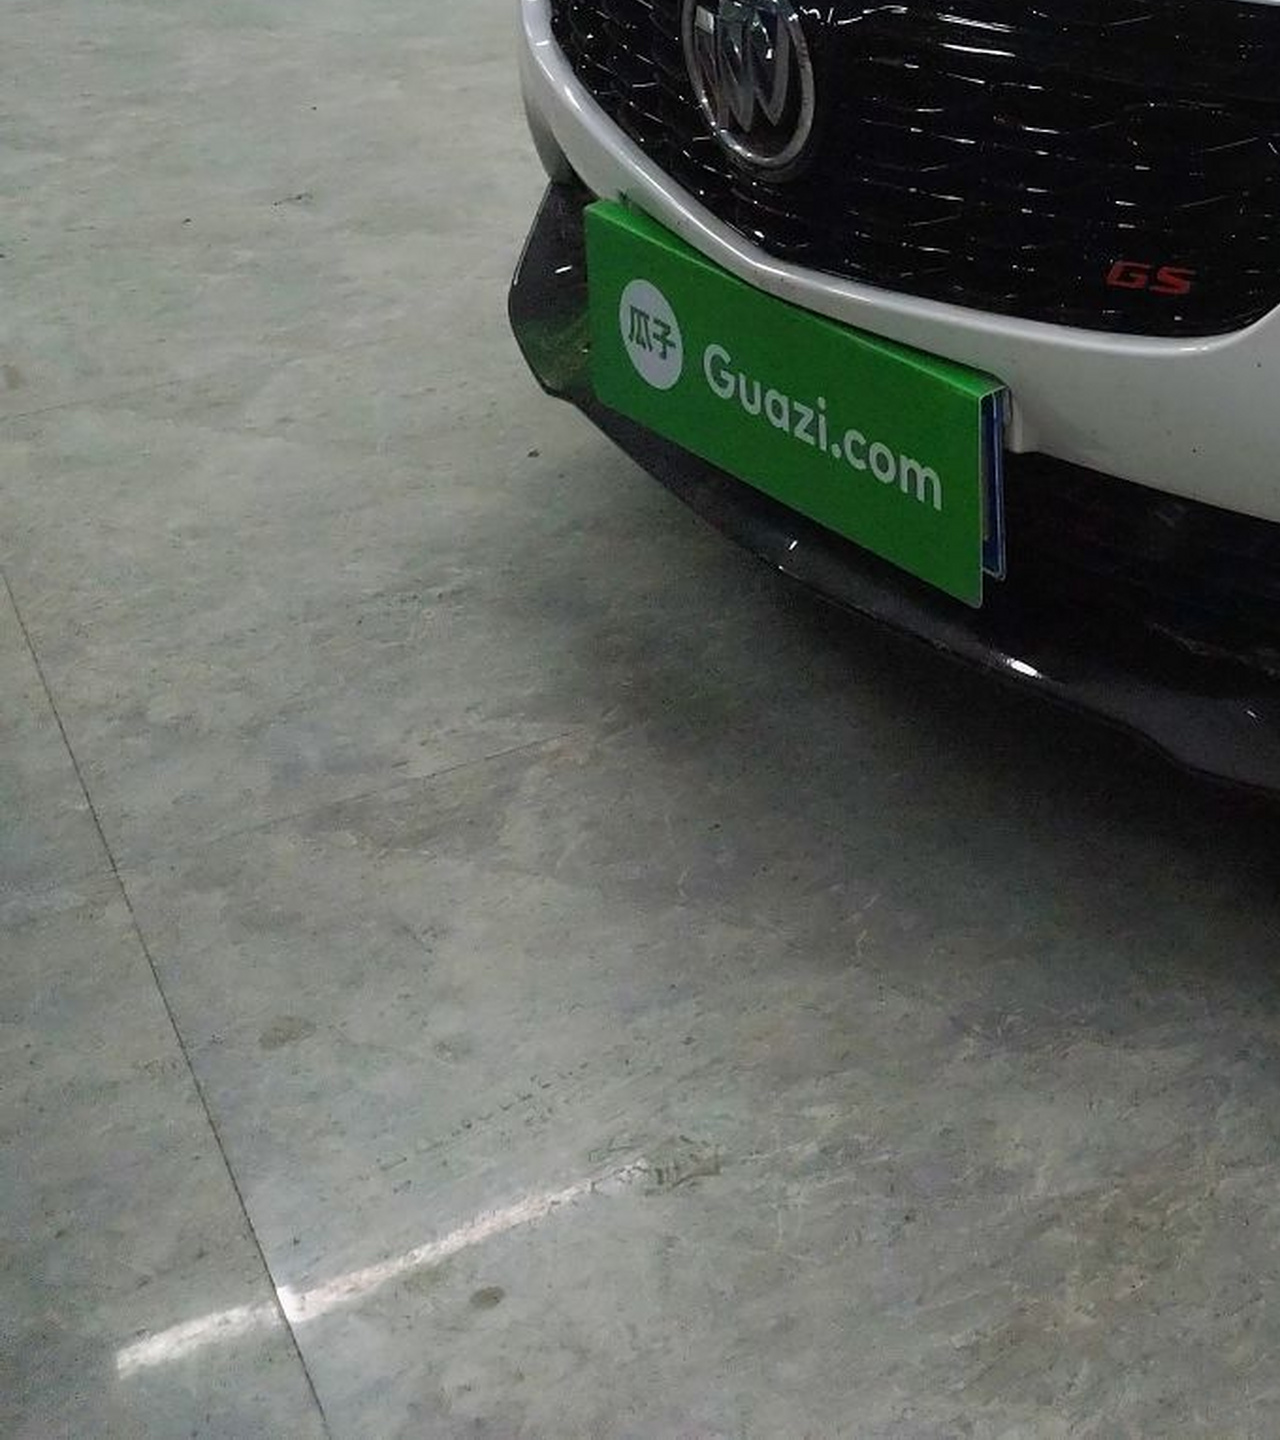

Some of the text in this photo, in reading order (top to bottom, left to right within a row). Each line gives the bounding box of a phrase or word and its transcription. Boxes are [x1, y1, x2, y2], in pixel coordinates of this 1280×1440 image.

[1105, 260, 1197, 295] GS
[629, 304, 677, 361] 瓜子
[703, 343, 942, 511] Guazi.com
